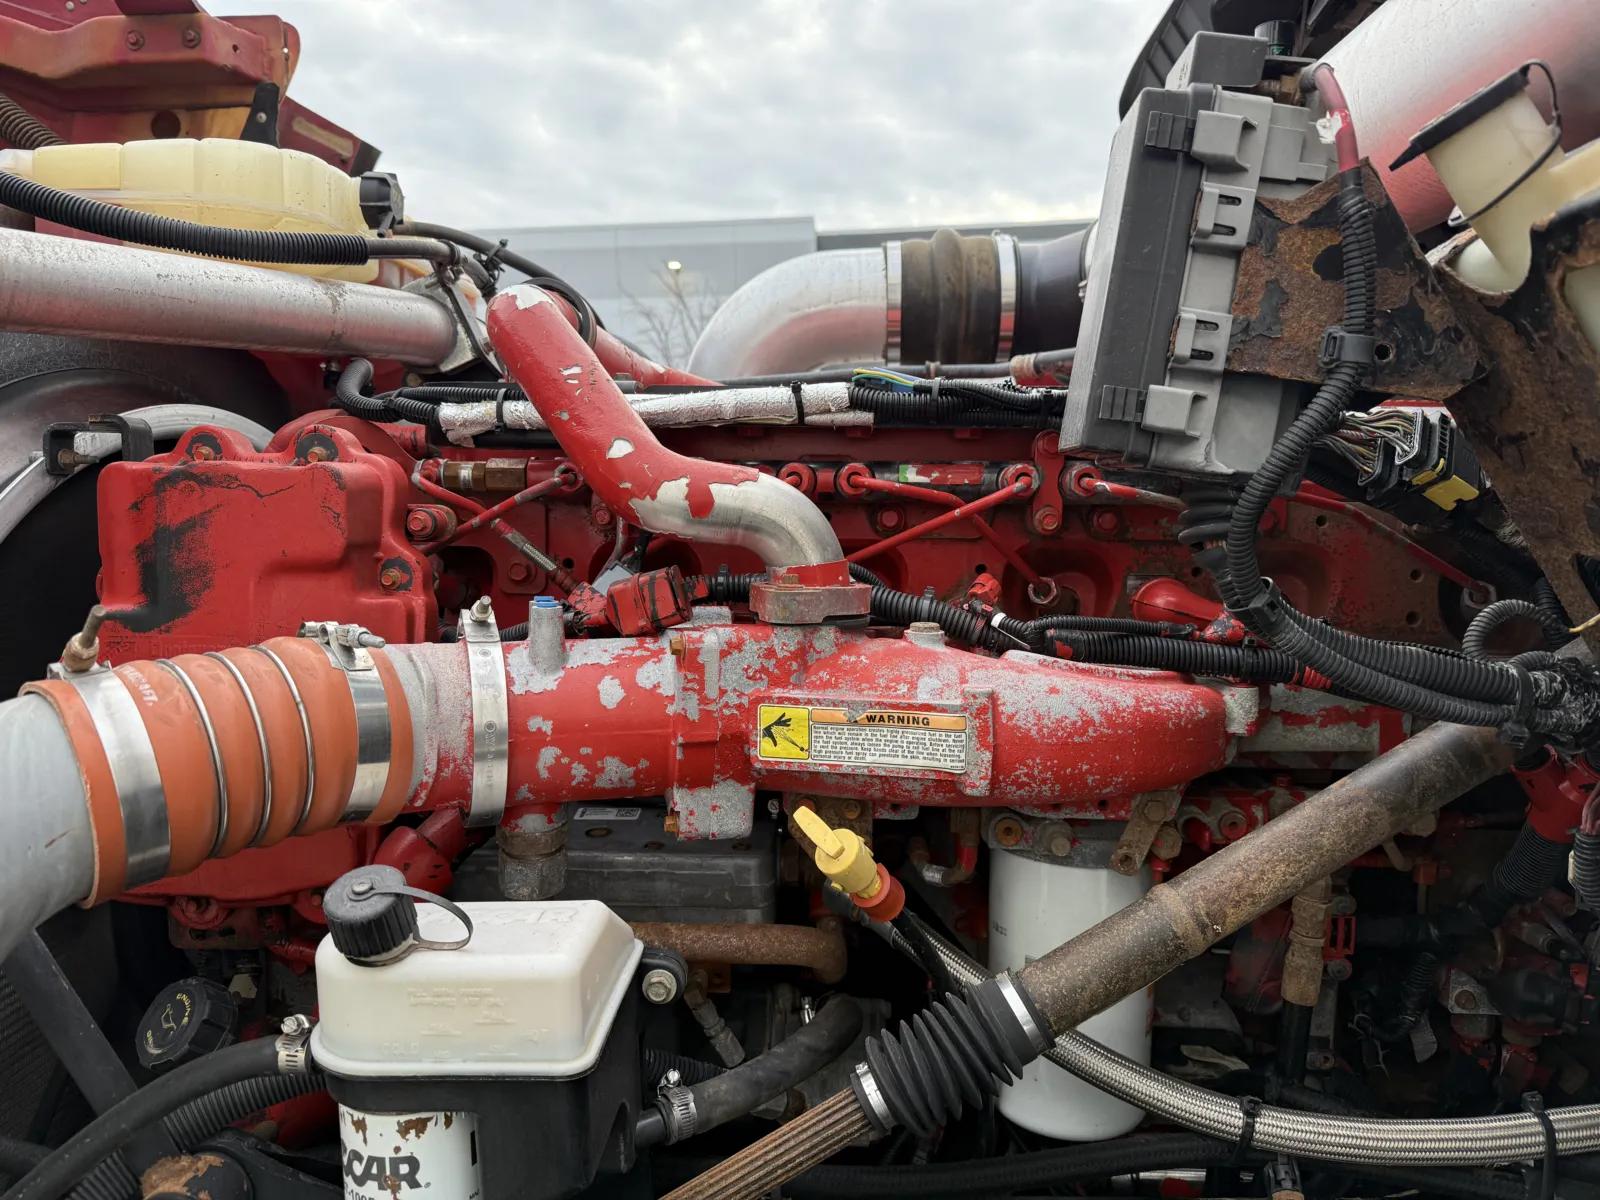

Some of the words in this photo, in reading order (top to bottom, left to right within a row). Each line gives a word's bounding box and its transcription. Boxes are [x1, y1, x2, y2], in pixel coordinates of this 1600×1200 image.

[866, 714, 930, 726] WARNING
[176, 992, 192, 1025] ENGINE
[341, 1140, 423, 1190] CAR
